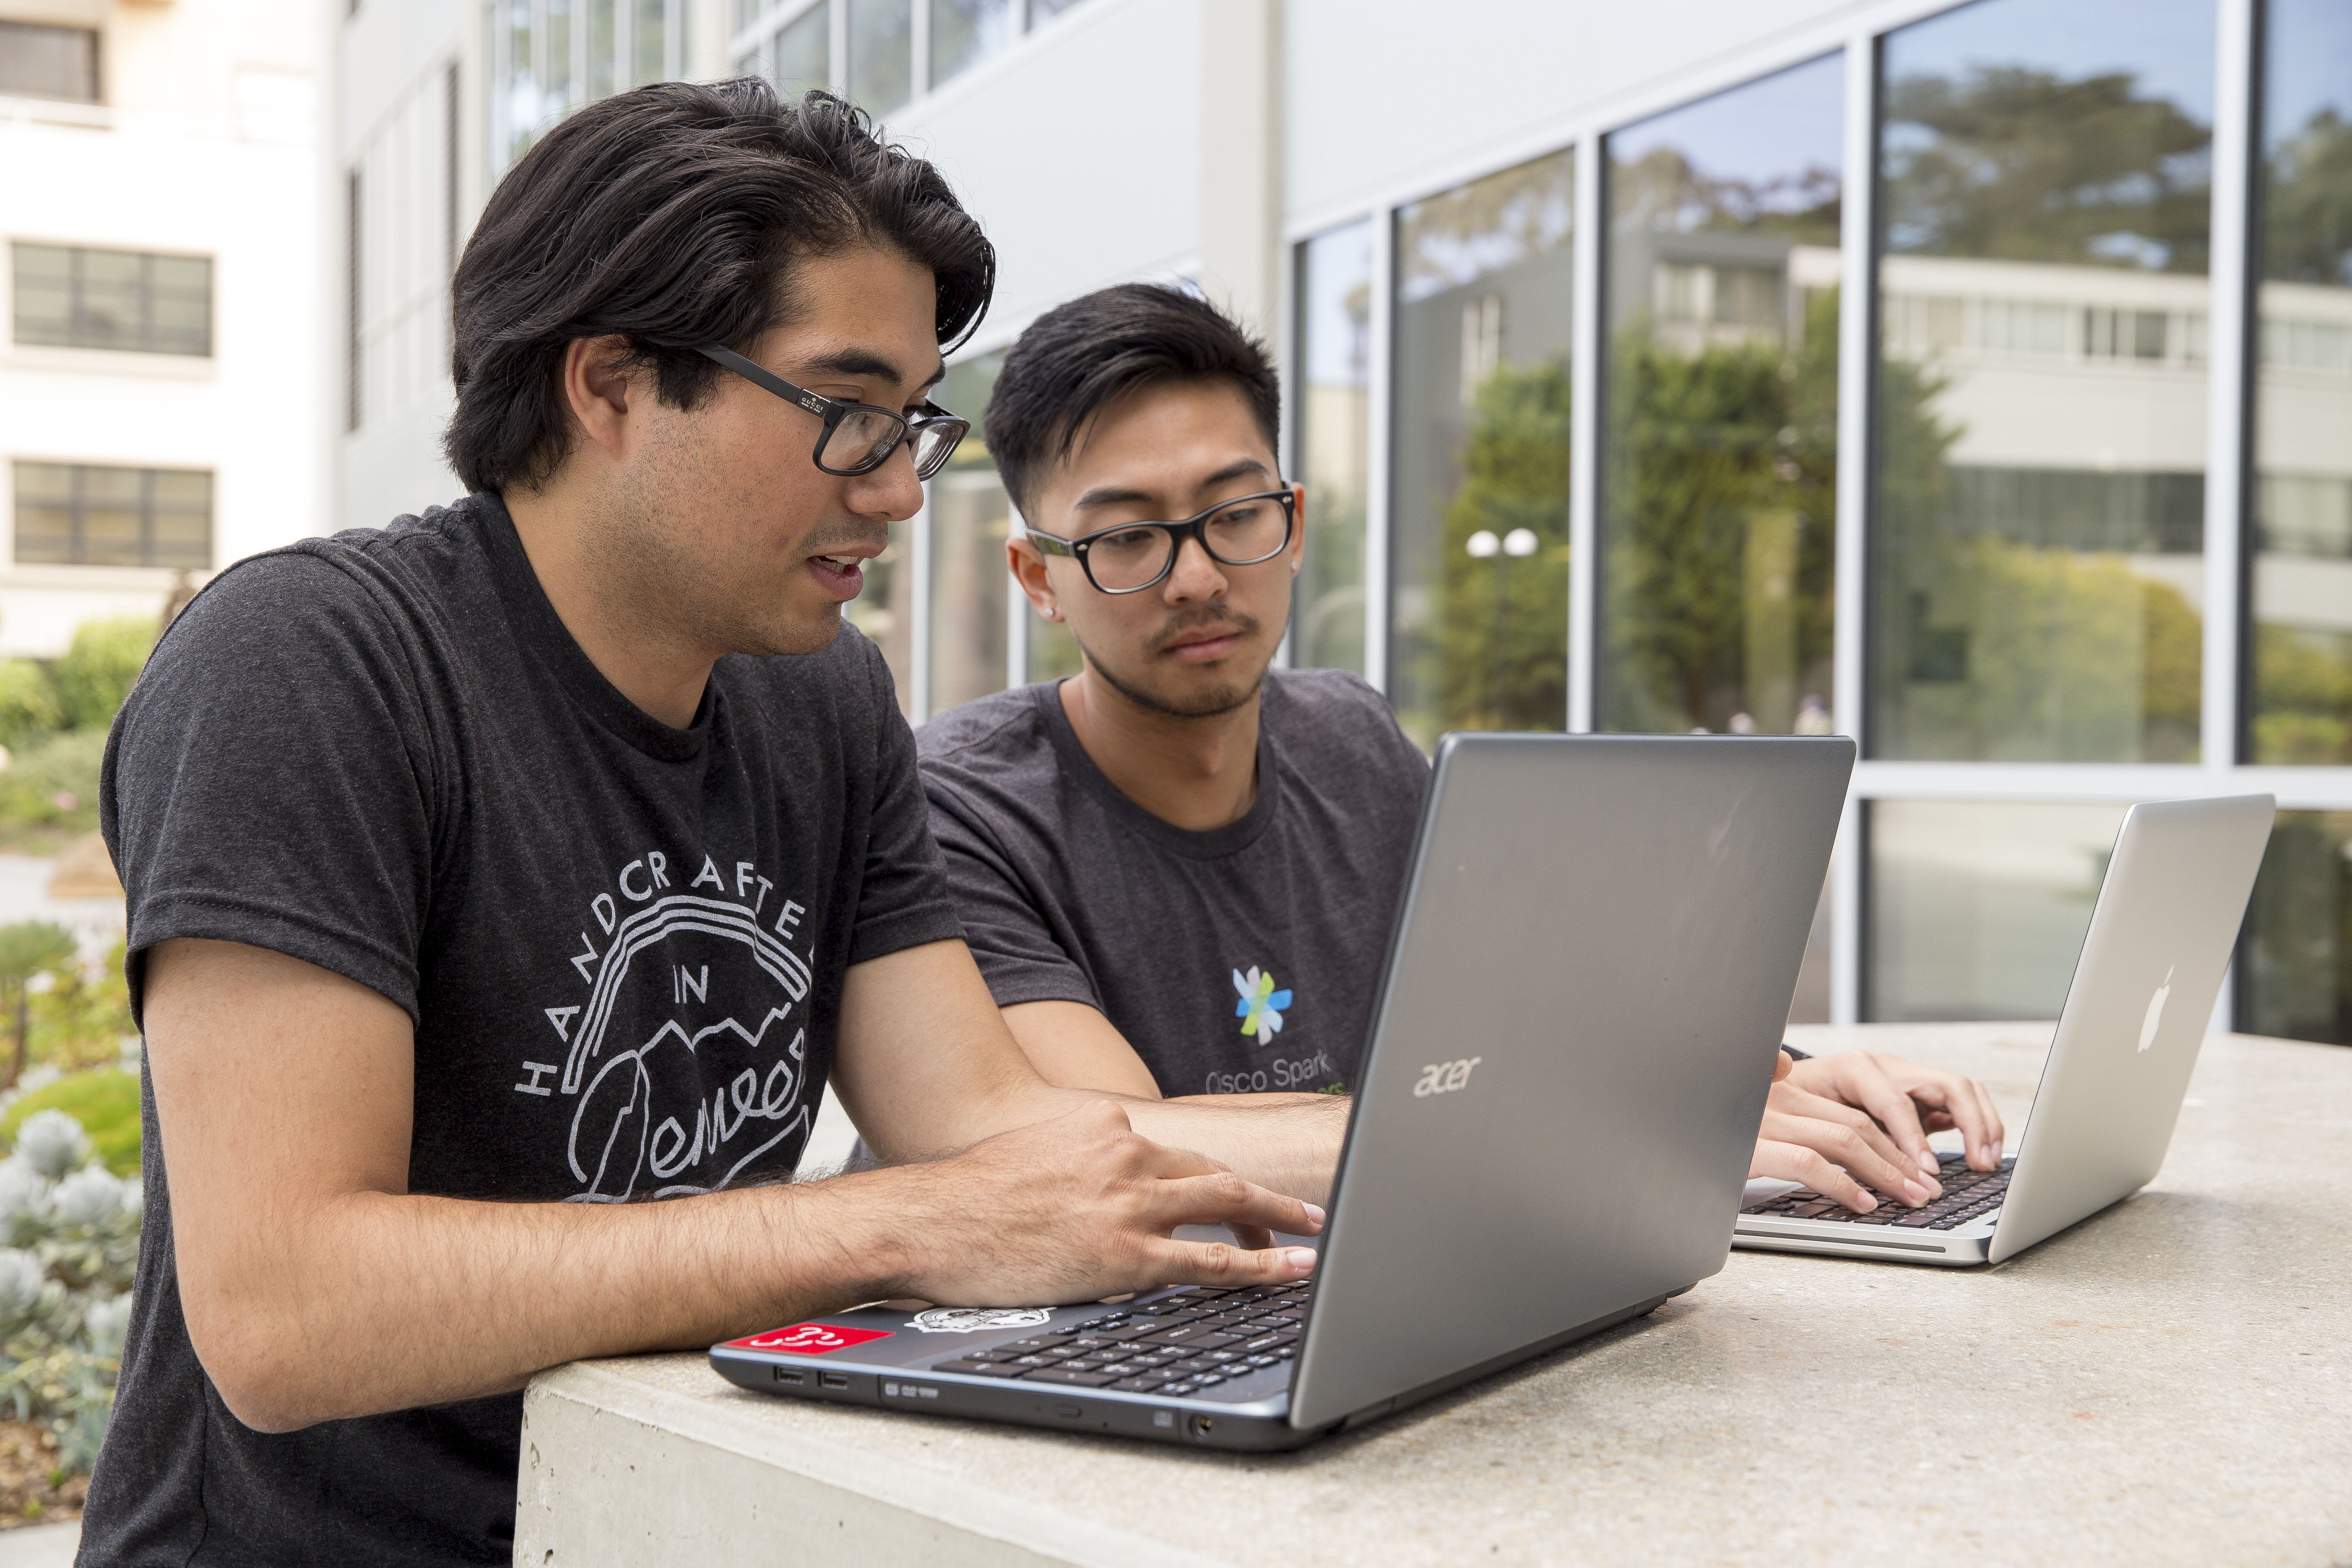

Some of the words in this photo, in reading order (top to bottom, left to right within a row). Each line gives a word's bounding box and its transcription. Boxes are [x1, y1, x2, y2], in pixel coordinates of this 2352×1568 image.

[802, 398, 823, 410] GUCCI
[515, 851, 814, 1096] HANDCRAFTE
[672, 965, 708, 1004] IN
[1206, 1069, 1268, 1095] Cisco
[1272, 1048, 1332, 1090] Spark
[1413, 1056, 1482, 1097] acer
